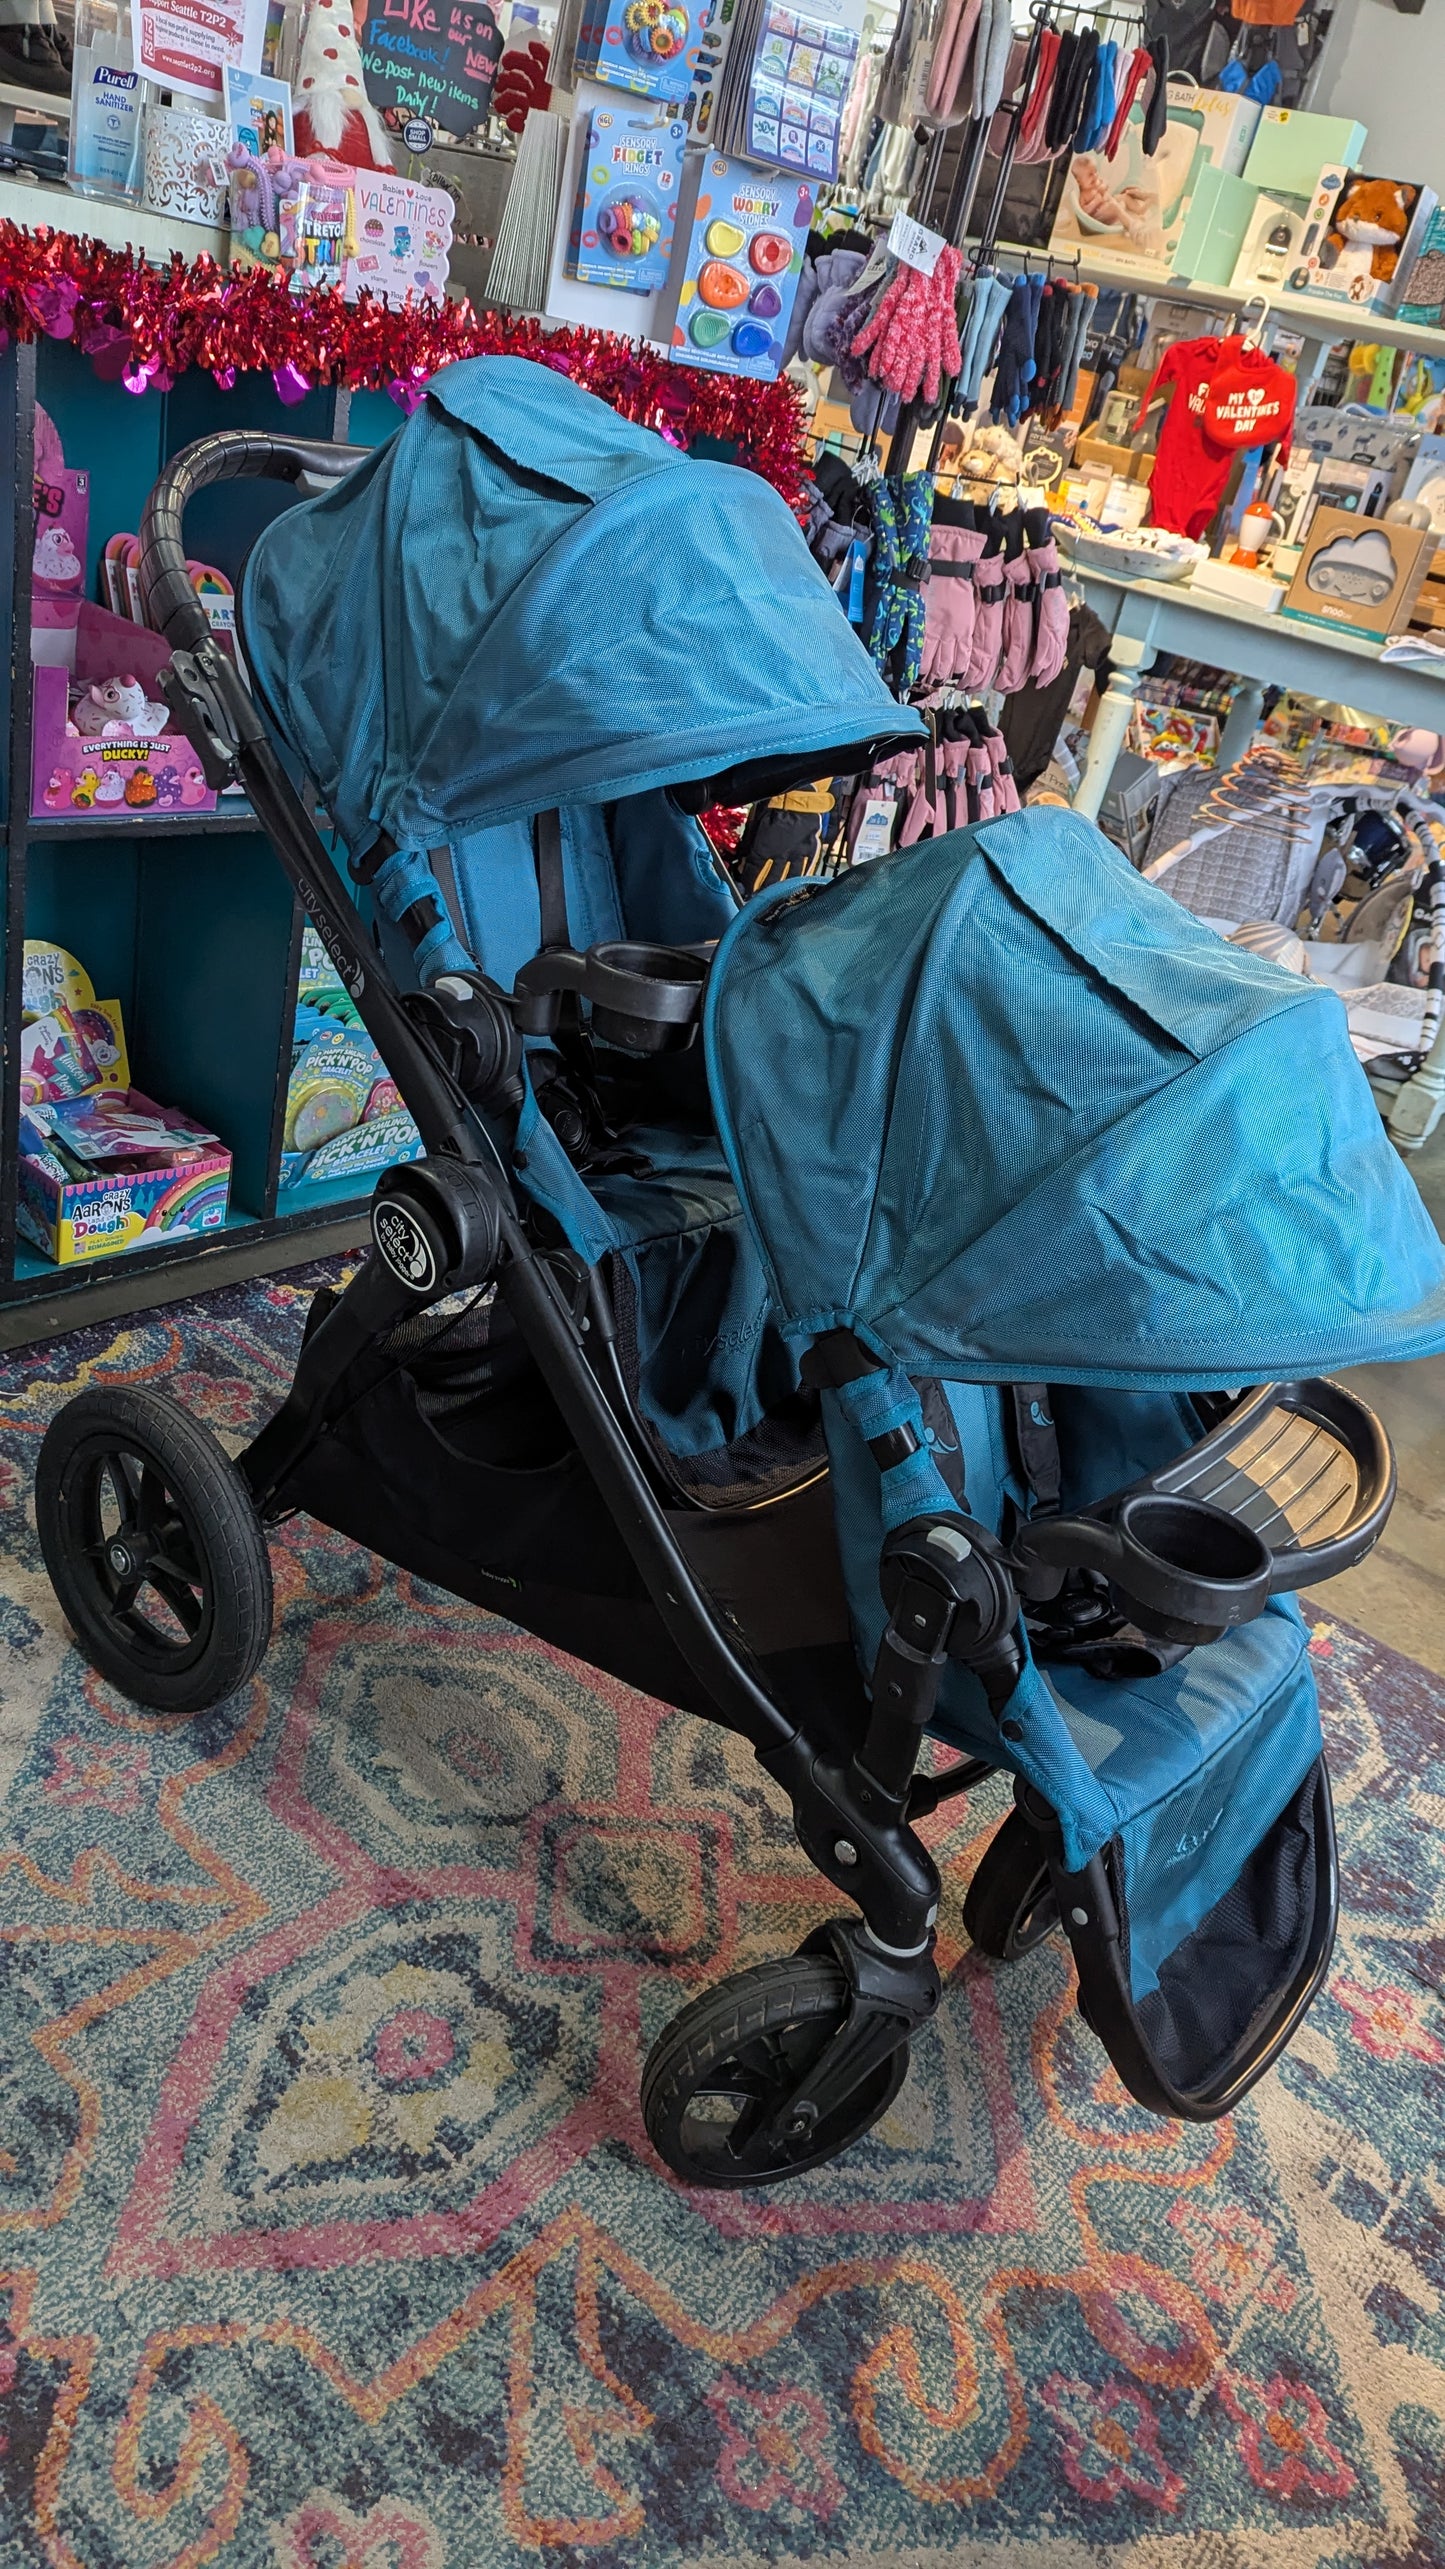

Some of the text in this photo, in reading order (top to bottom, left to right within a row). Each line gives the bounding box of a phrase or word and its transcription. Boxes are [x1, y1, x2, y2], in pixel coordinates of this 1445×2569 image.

[170, 0, 198, 19] Seattle
[200, 10, 226, 28] T2P2
[450, 7, 473, 30] us
[475, 23, 493, 40] on
[466, 47, 497, 75] NEW
[98, 67, 135, 89] Purell
[359, 47, 479, 110] We post new items
[95, 97, 134, 113] SANITIZER
[103, 91, 127, 104] HAND
[1174, 91, 1196, 103] BATH
[409, 128, 426, 136] SHOP
[672, 126, 682, 137] 3+
[620, 135, 657, 149] SENSORY
[612, 146, 664, 166] FIDGET
[625, 163, 650, 174] RINGS
[661, 172, 672, 183] 12
[382, 184, 405, 197] Babies
[740, 185, 776, 200] SENSORY
[360, 189, 447, 228] VALENTINES
[733, 196, 780, 217] WORRY
[740, 213, 769, 226] STONES
[1228, 392, 1245, 406] MY
[1234, 419, 1257, 434] DAY
[82, 740, 171, 754] EVERYTHING IS JUST
[103, 748, 149, 761] DUCKY!
[315, 914, 353, 978] select
[344, 1048, 367, 1060] SMILING
[59, 1053, 92, 1085] Unicorn
[321, 1066, 353, 1076] BRACELET
[369, 1116, 409, 1134] SMILING
[332, 1144, 390, 1168] BRACELET
[73, 1215, 129, 1239] Dough
[391, 1216, 410, 1241] city
[380, 1218, 410, 1262] select
[380, 1231, 387, 1243] by
[386, 1241, 397, 1259] baby
